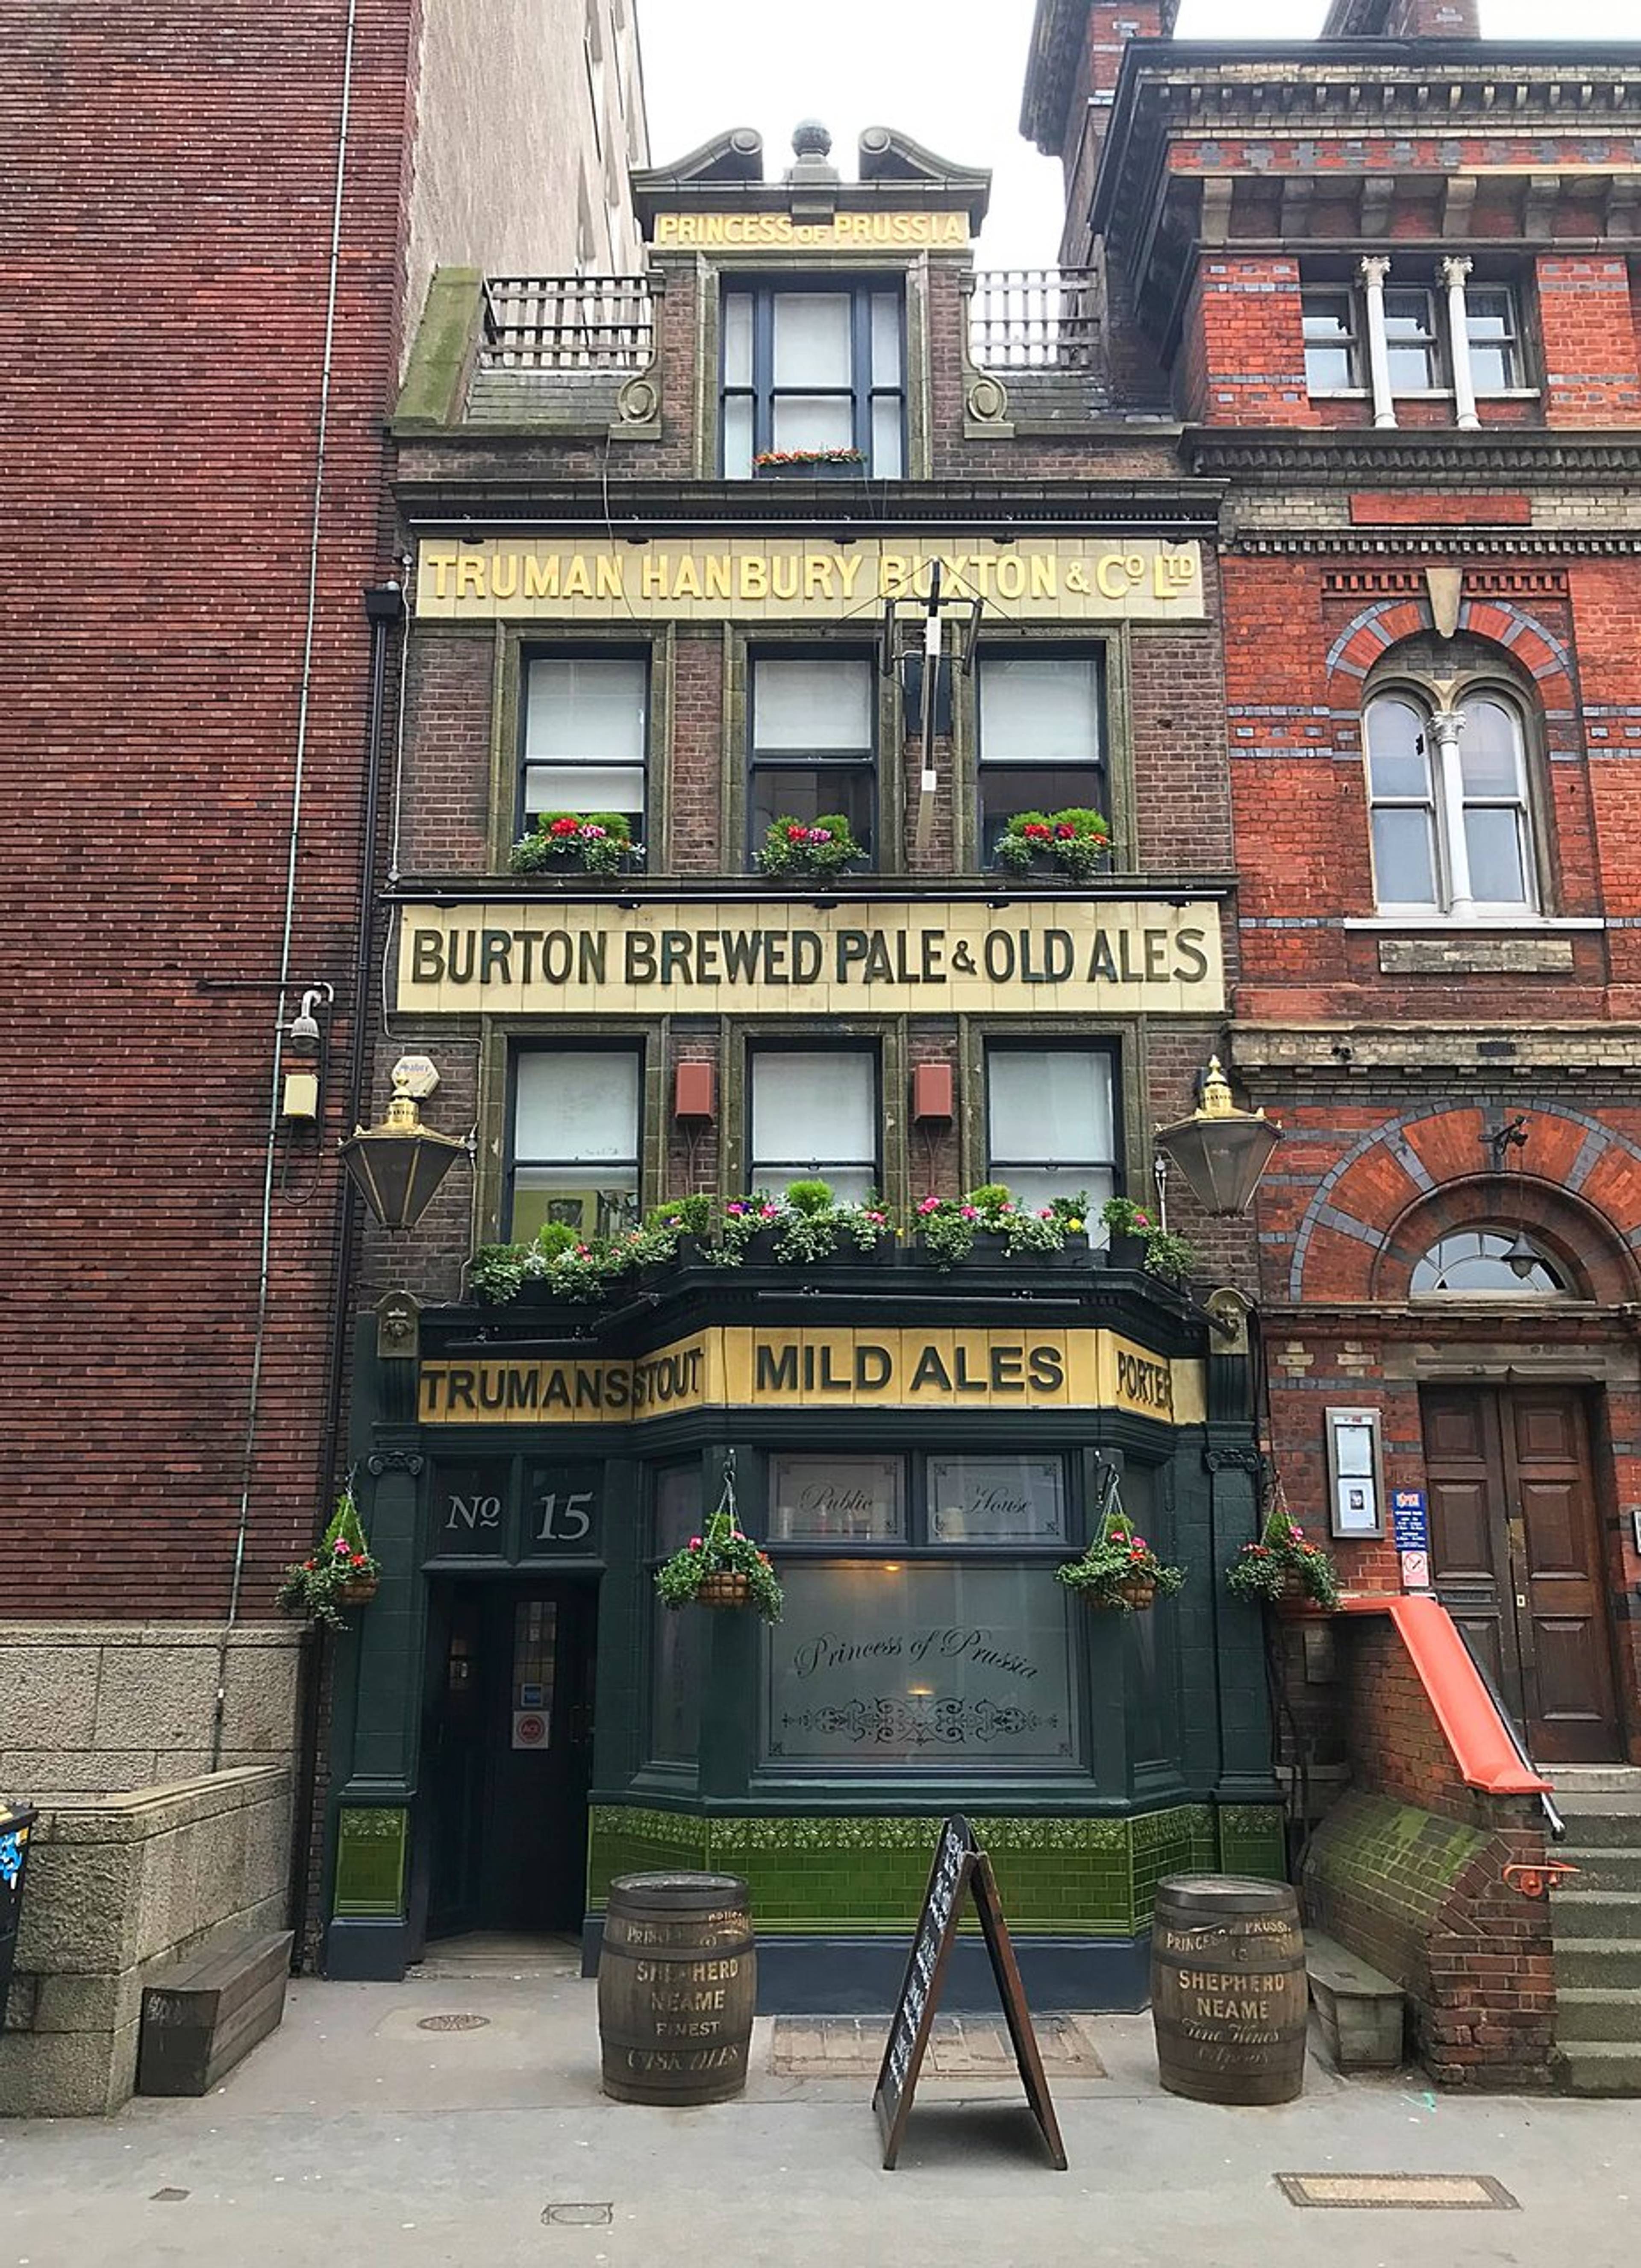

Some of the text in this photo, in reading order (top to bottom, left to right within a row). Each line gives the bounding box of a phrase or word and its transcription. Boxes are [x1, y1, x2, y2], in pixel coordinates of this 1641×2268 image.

[660, 215, 963, 244] PRINCESS OF PRUSSIA
[428, 555, 623, 599] TRUMAN
[642, 555, 864, 599] HANBURY
[880, 555, 1057, 599] BUXTON
[1065, 561, 1091, 594] &
[412, 928, 1208, 984] BURTON BREWED PALE & OLD ALES
[422, 1369, 629, 1410] TRUMANS
[632, 1347, 704, 1408] STOUT
[756, 1345, 1065, 1392] MILD ALES
[1116, 1351, 1174, 1412] PORTER
[537, 1492, 593, 1539] 15
[800, 1484, 874, 1512] Public
[959, 1484, 1031, 1514] House
[794, 1626, 1038, 1680] Princess of Prussia
[1179, 1969, 1285, 1992] SHEPHERD
[1197, 1998, 1269, 2020] NEAME
